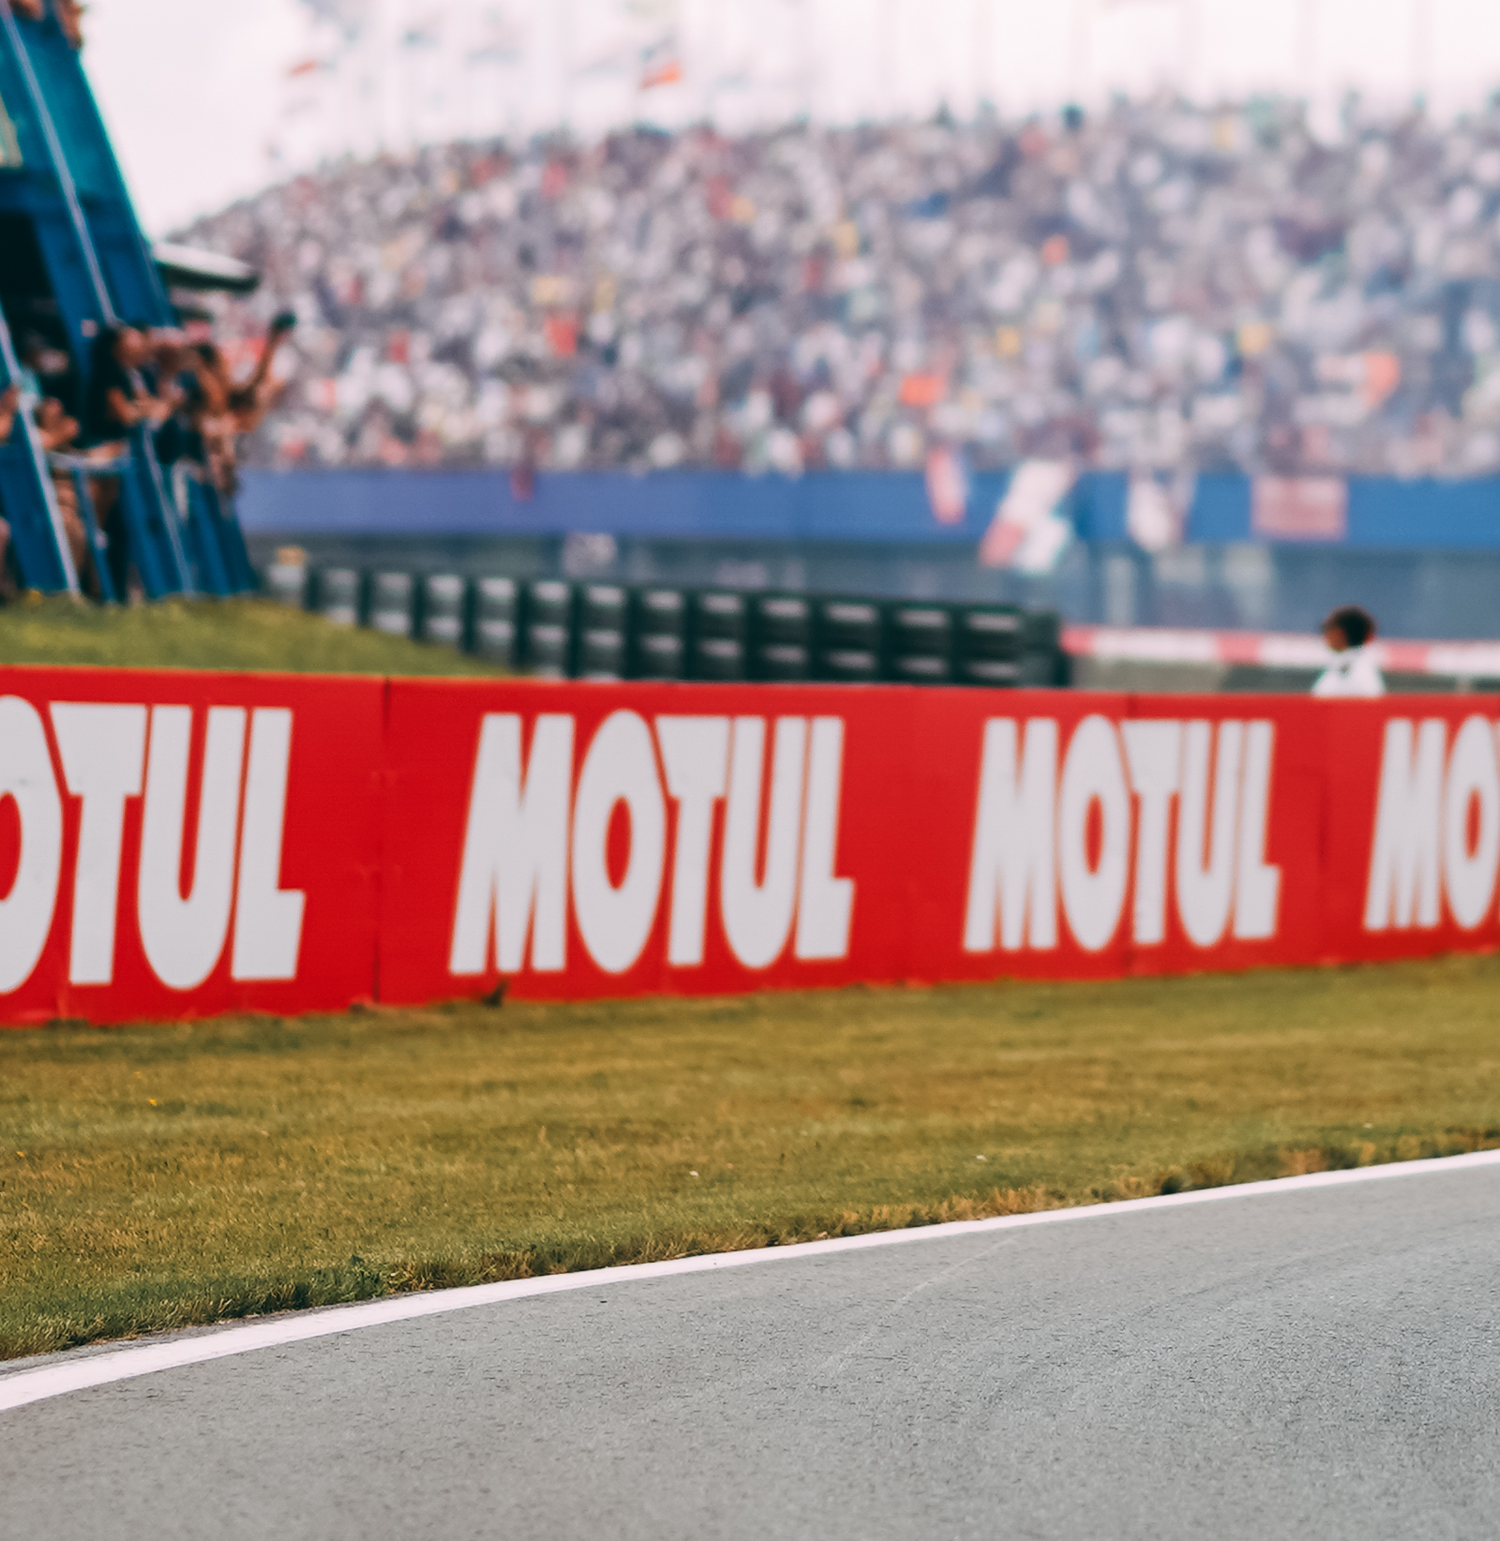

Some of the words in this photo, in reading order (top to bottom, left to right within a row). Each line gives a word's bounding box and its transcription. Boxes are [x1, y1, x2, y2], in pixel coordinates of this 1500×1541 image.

[0, 695, 306, 994] OTUL
[449, 708, 856, 976] MOTUL
[962, 713, 1281, 953] MOTUL
